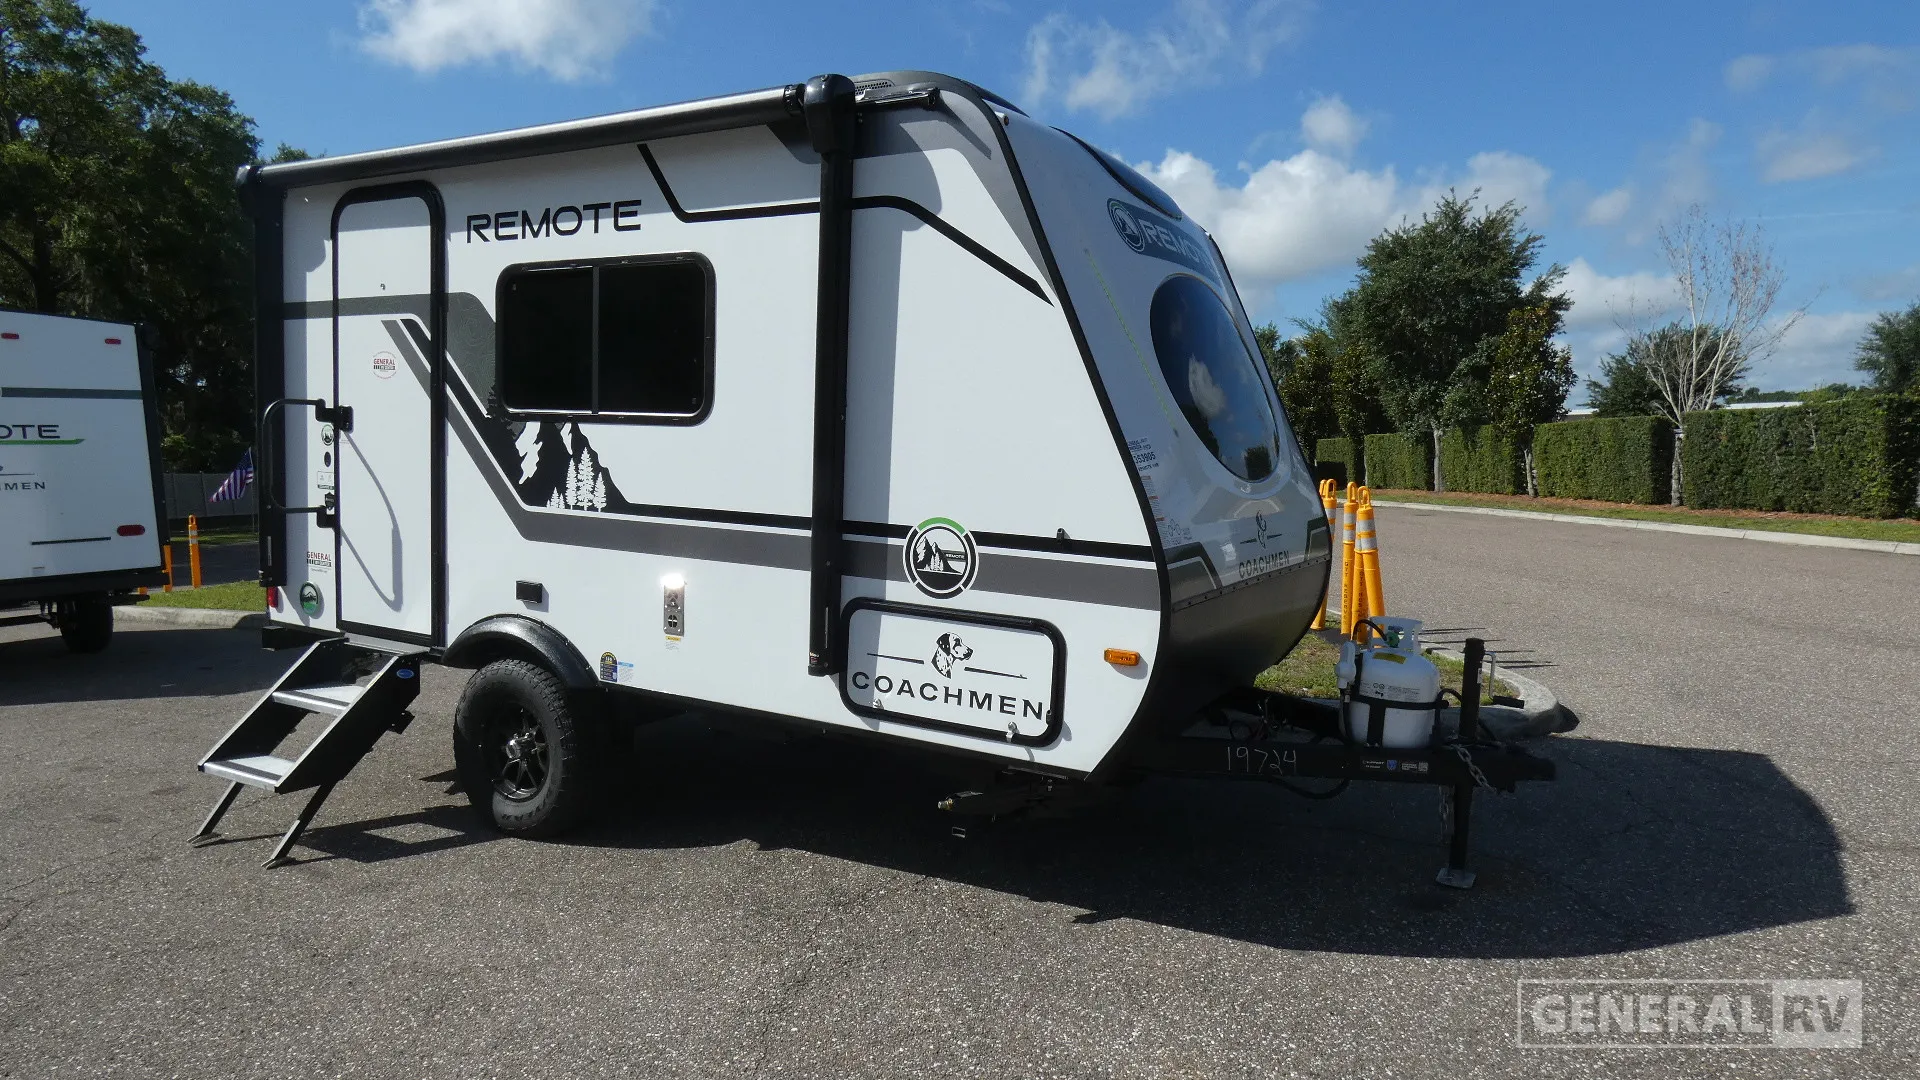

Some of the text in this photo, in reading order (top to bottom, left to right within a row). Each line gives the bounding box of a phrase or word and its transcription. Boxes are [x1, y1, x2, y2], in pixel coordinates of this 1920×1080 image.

[467, 200, 642, 243] REMOTE
[0, 482, 46, 491] MEN
[306, 551, 332, 561] GENERAL
[1238, 550, 1290, 579] COACHMEN
[852, 671, 1043, 721] COACHMEN
[1227, 746, 1297, 775] 19724
